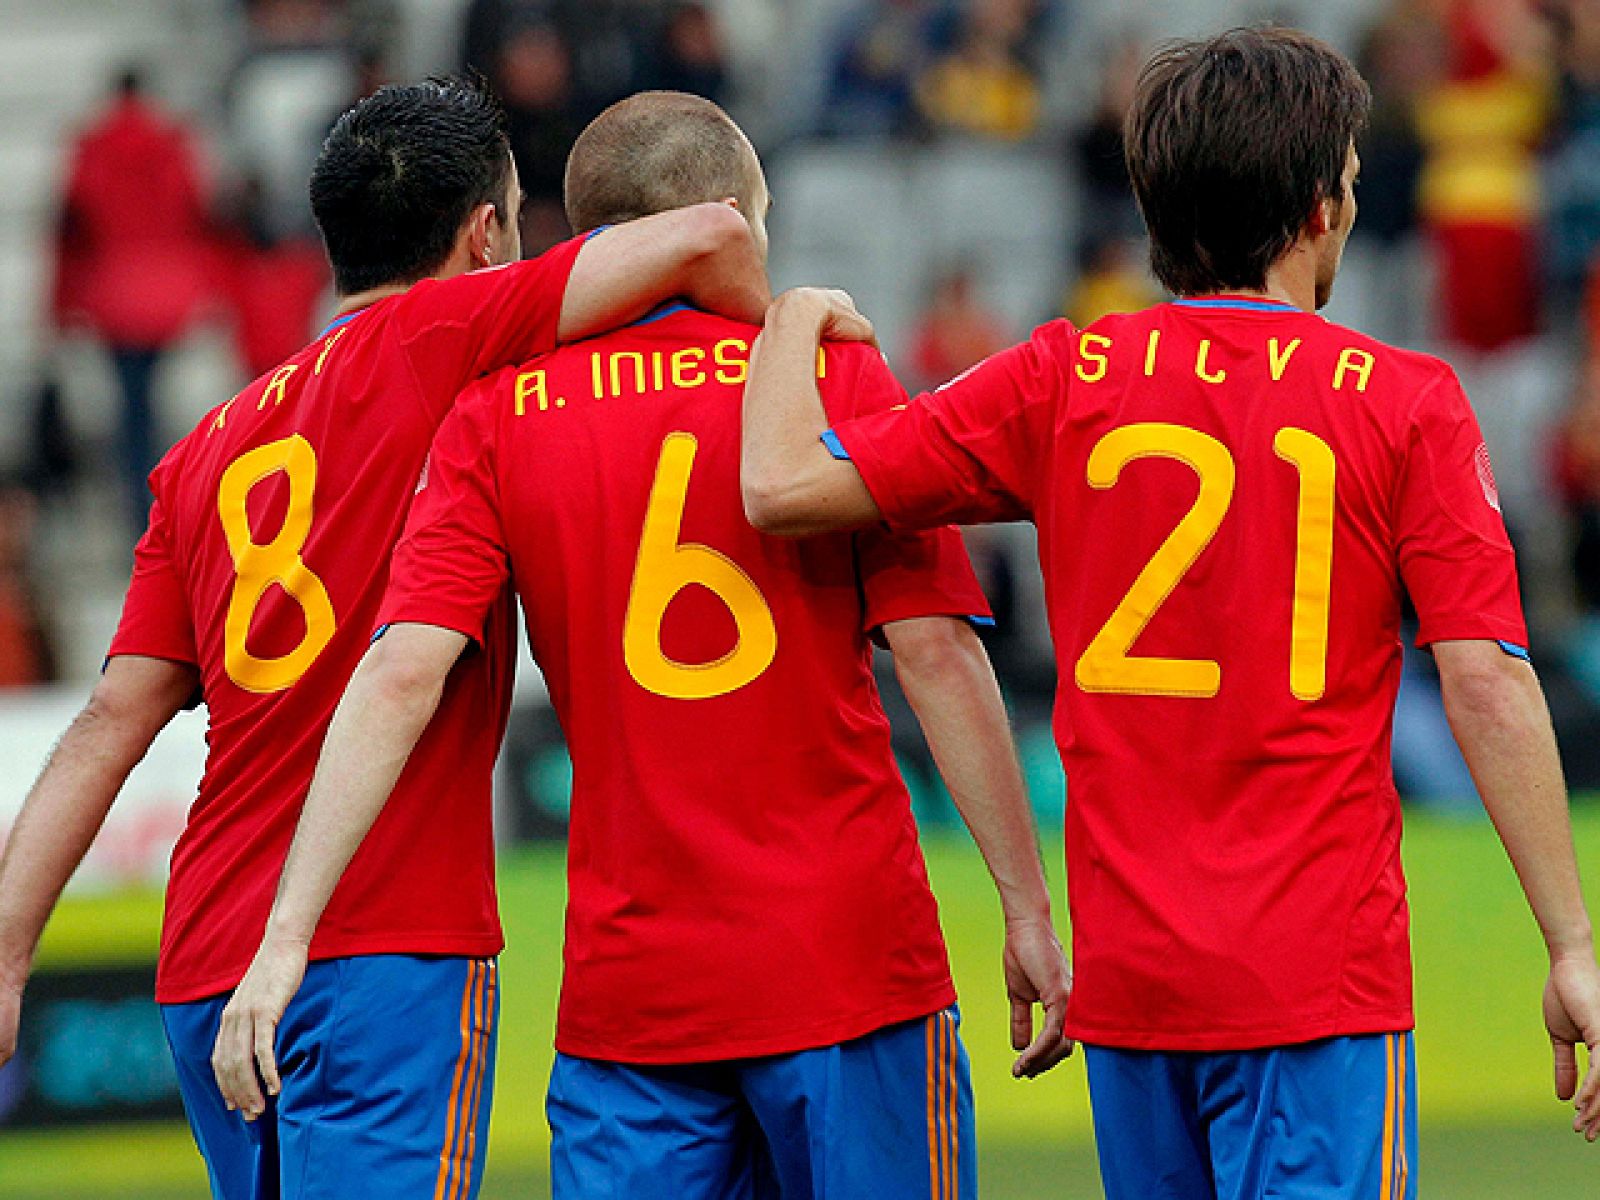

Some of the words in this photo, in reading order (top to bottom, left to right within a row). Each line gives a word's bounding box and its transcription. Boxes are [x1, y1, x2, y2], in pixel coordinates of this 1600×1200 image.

[514, 369, 566, 416] A.
[591, 338, 827, 399] INIES
[1075, 329, 1376, 392] SILVA
[217, 432, 337, 694] 8
[623, 431, 778, 700] 6
[1075, 422, 1336, 701] 21
